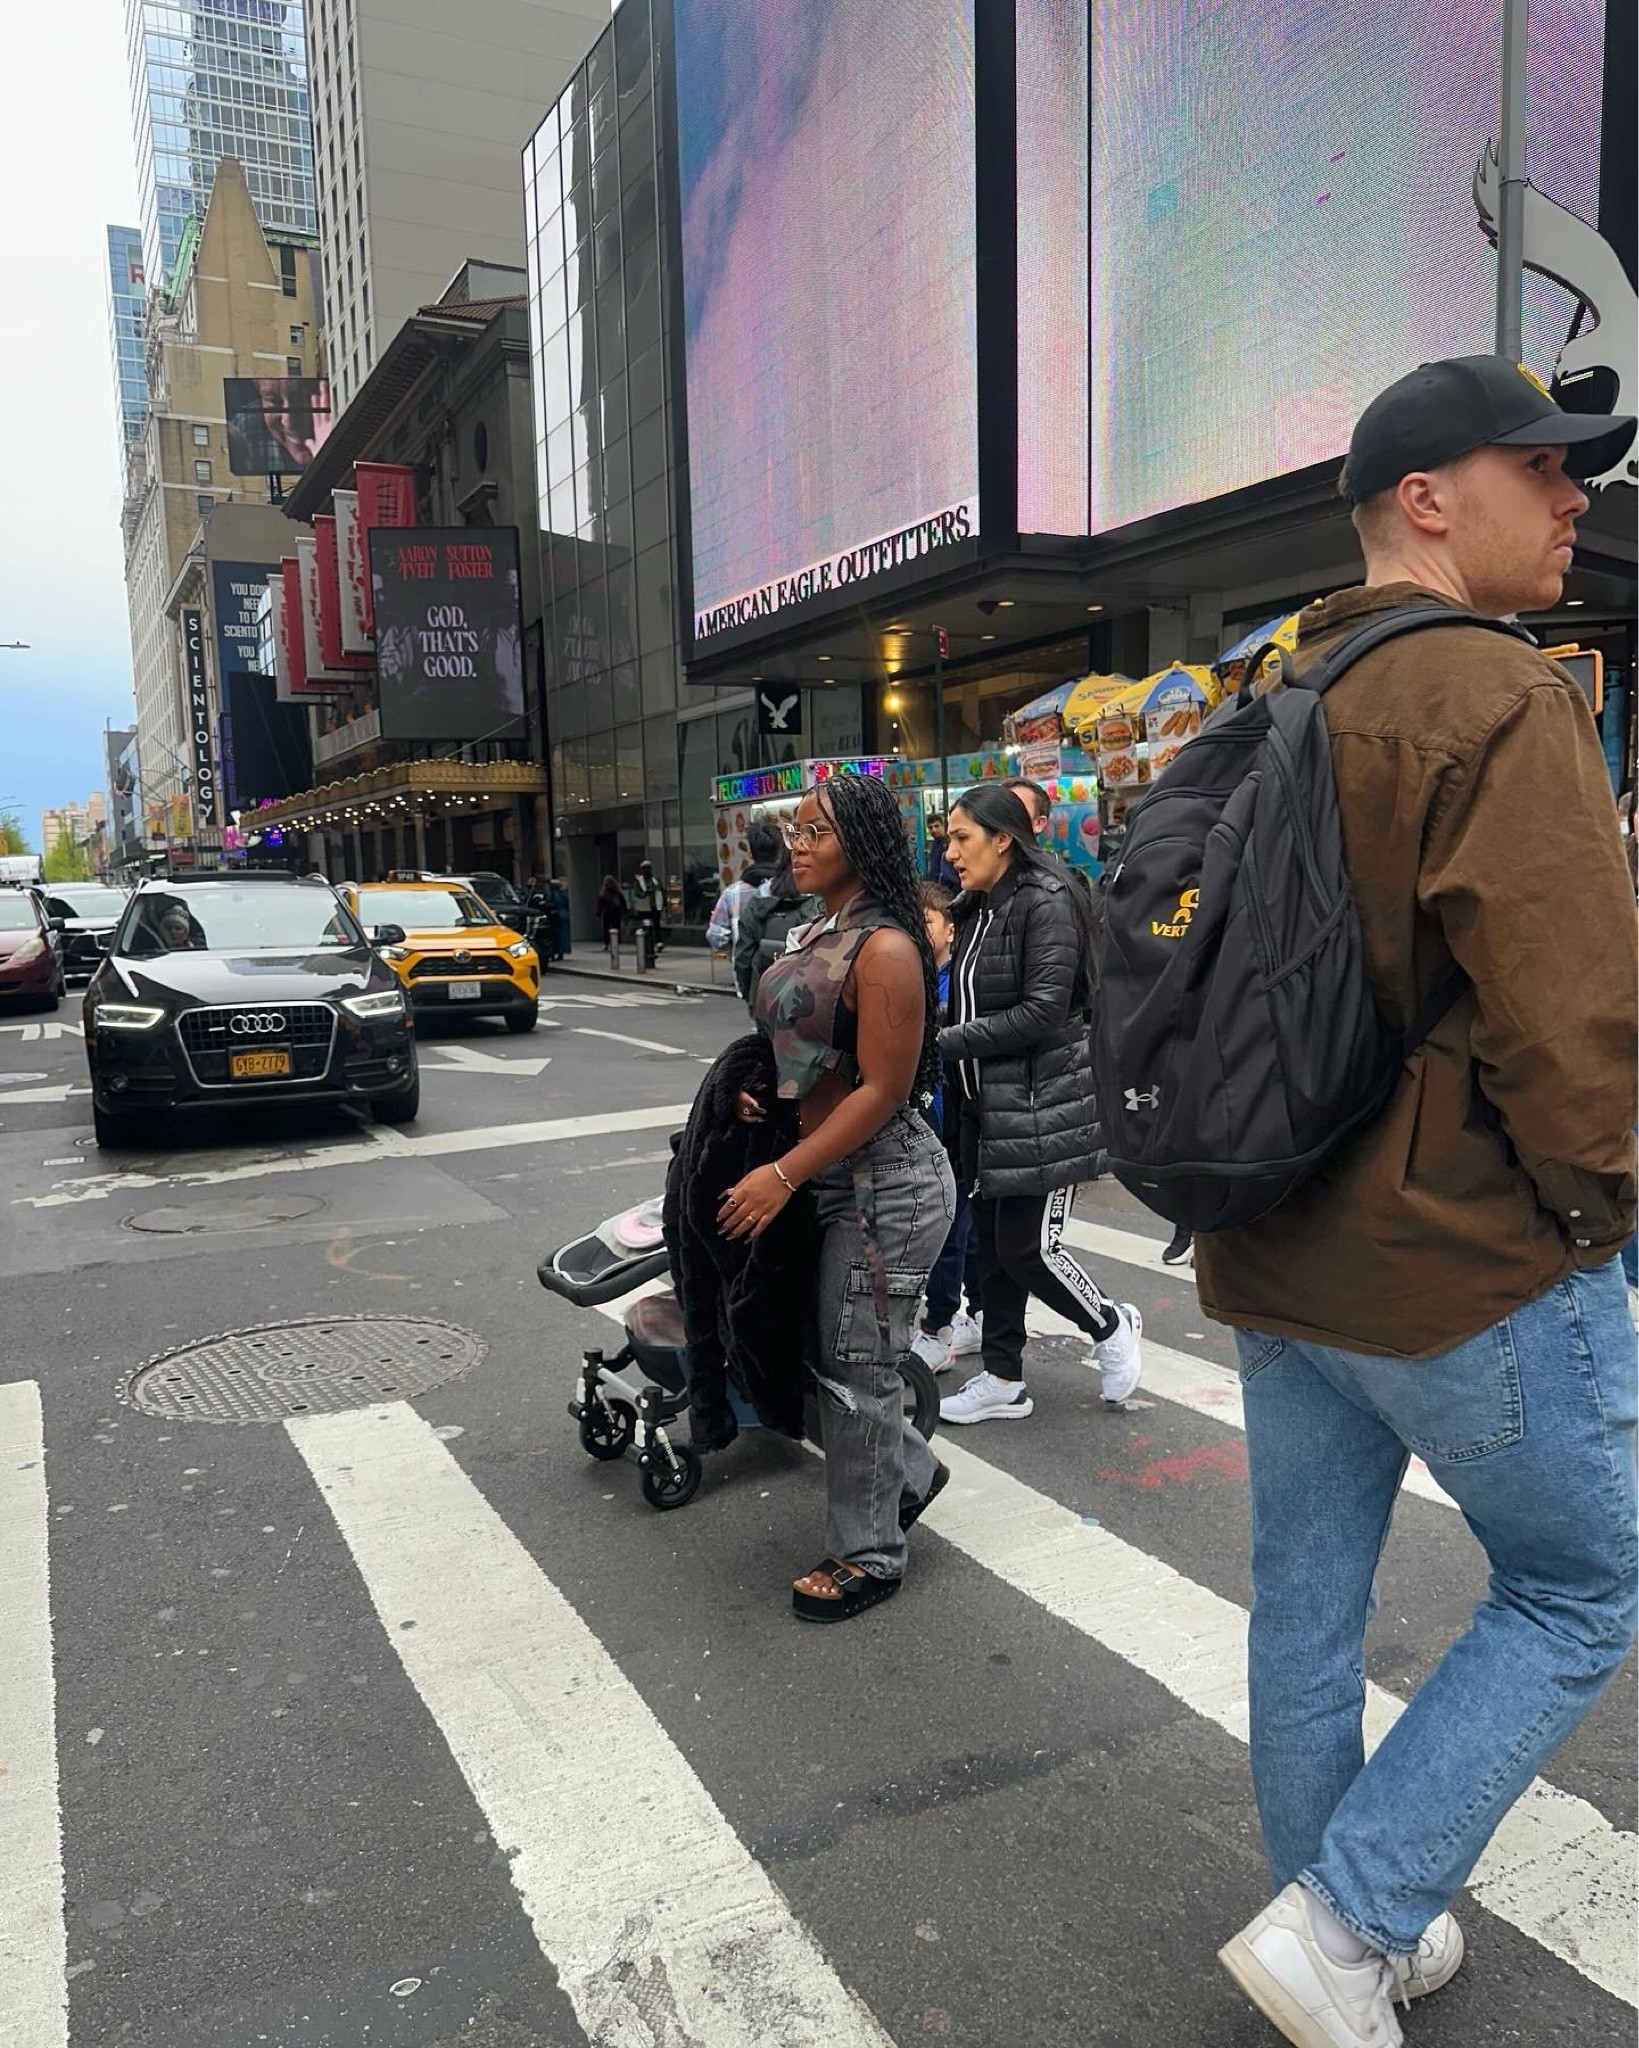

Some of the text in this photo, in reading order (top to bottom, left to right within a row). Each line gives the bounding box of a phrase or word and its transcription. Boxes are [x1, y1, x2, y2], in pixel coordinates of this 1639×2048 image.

[397, 545, 437, 562] AARON
[445, 545, 492, 562] SUTTON
[447, 562, 494, 581] FOSTER
[698, 505, 971, 637] AMERICAN EAGLE OUTFITTERS
[230, 582, 248, 595] YOU
[243, 597, 259, 610] NEE
[239, 611, 250, 623] TO
[224, 625, 257, 638] SCIENTO
[419, 631, 479, 652] THAT'S
[237, 645, 255, 658] YOU
[423, 656, 478, 677] GOOD.
[188, 618, 213, 819] SCIENTOLOGY
[1151, 921, 1189, 937] VERT
[1050, 1188, 1066, 1218] ARIS
